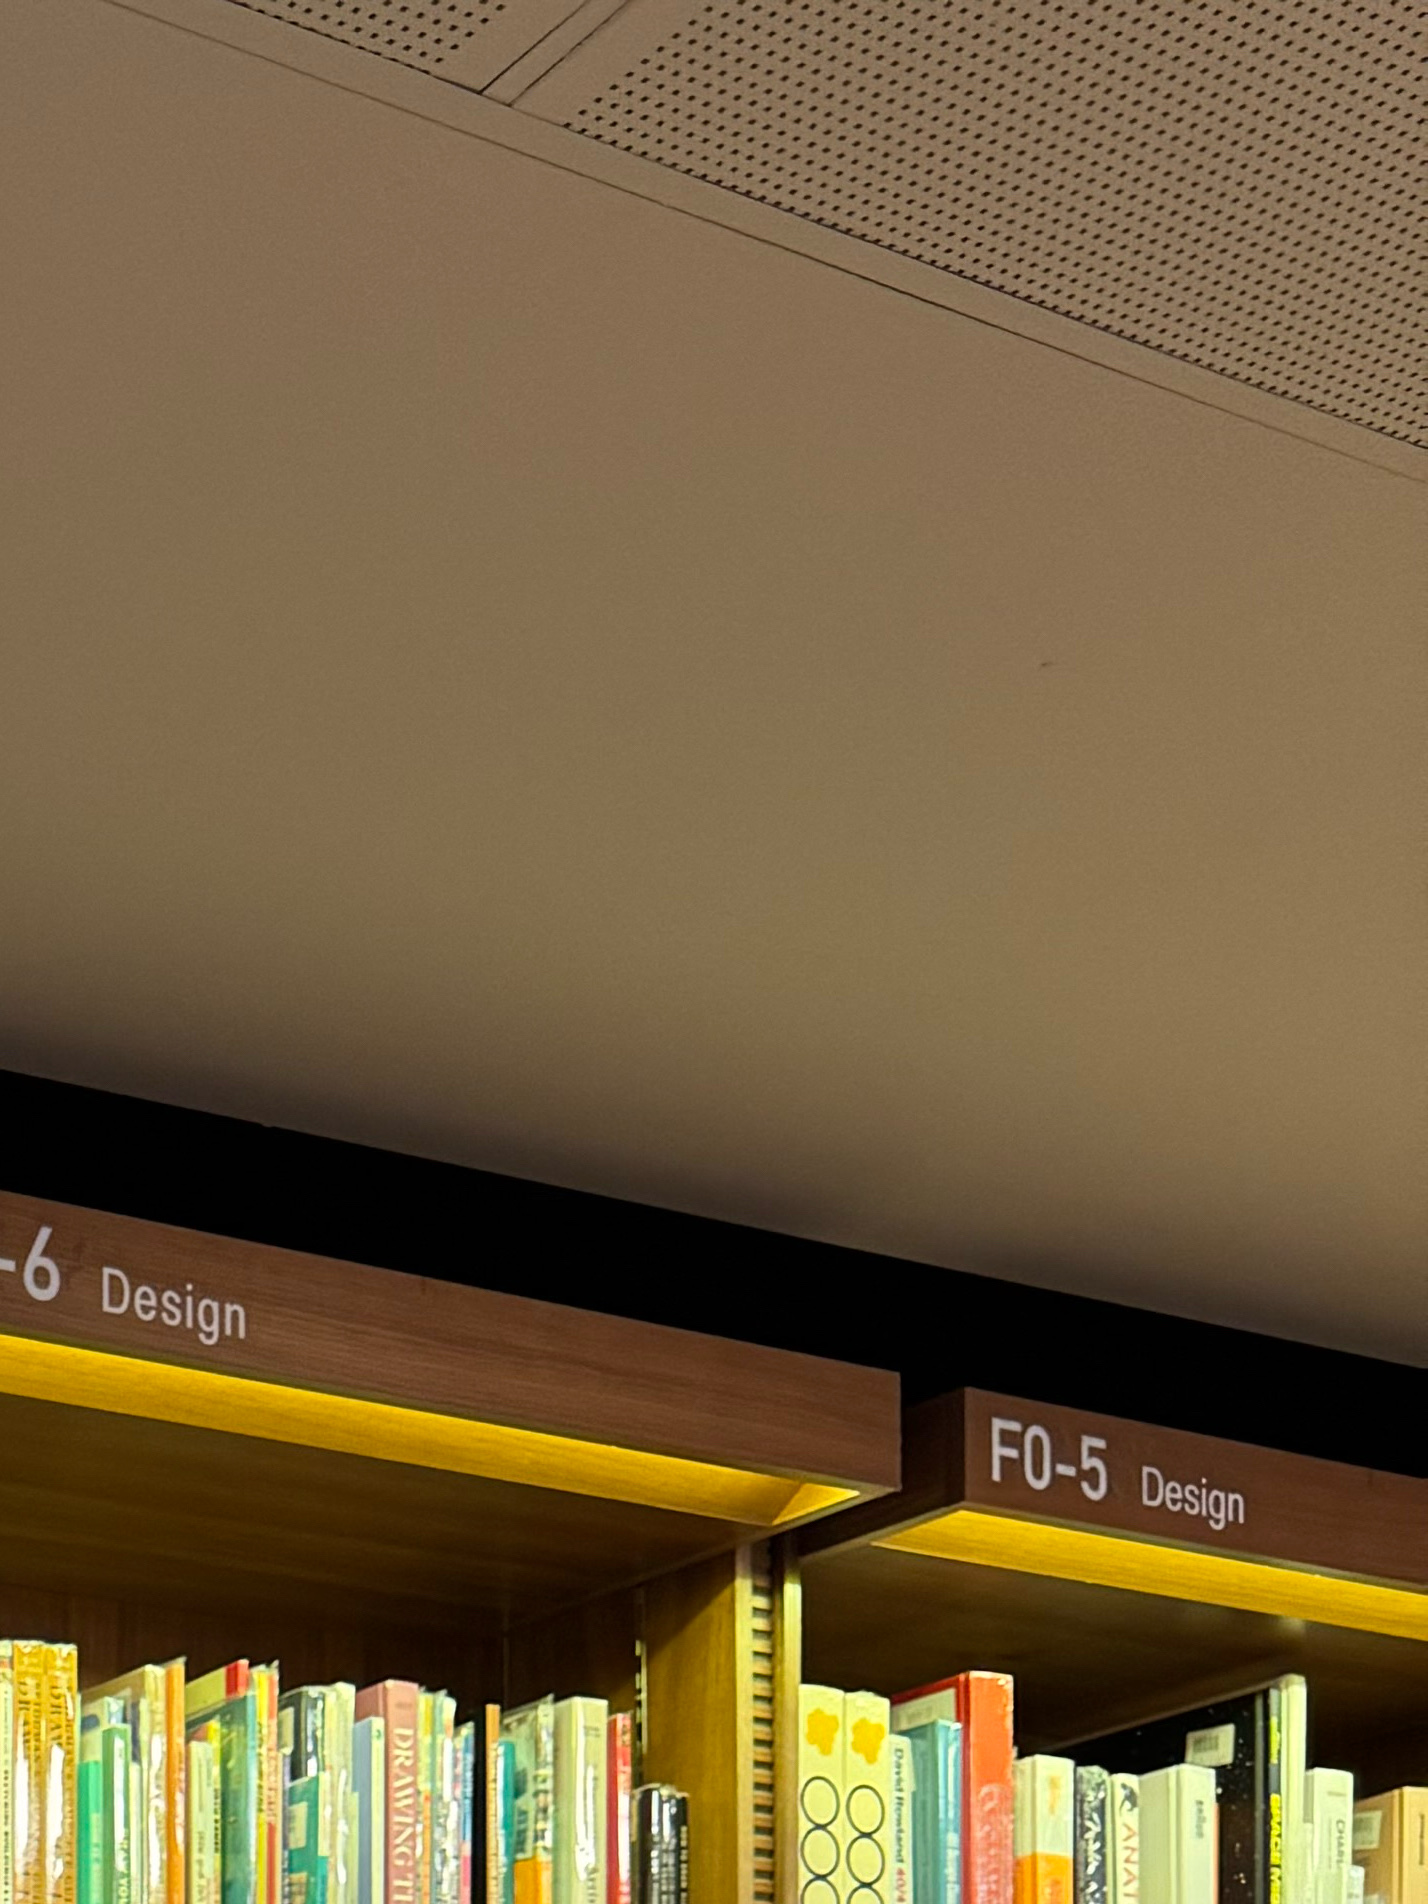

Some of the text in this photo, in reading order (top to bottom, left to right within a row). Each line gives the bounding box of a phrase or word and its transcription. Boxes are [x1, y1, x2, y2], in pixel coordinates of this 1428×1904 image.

[102, 1266, 245, 1345] Design
[991, 1417, 1244, 1530] F0-5 Design
[391, 1726, 415, 1863] DRAWING
